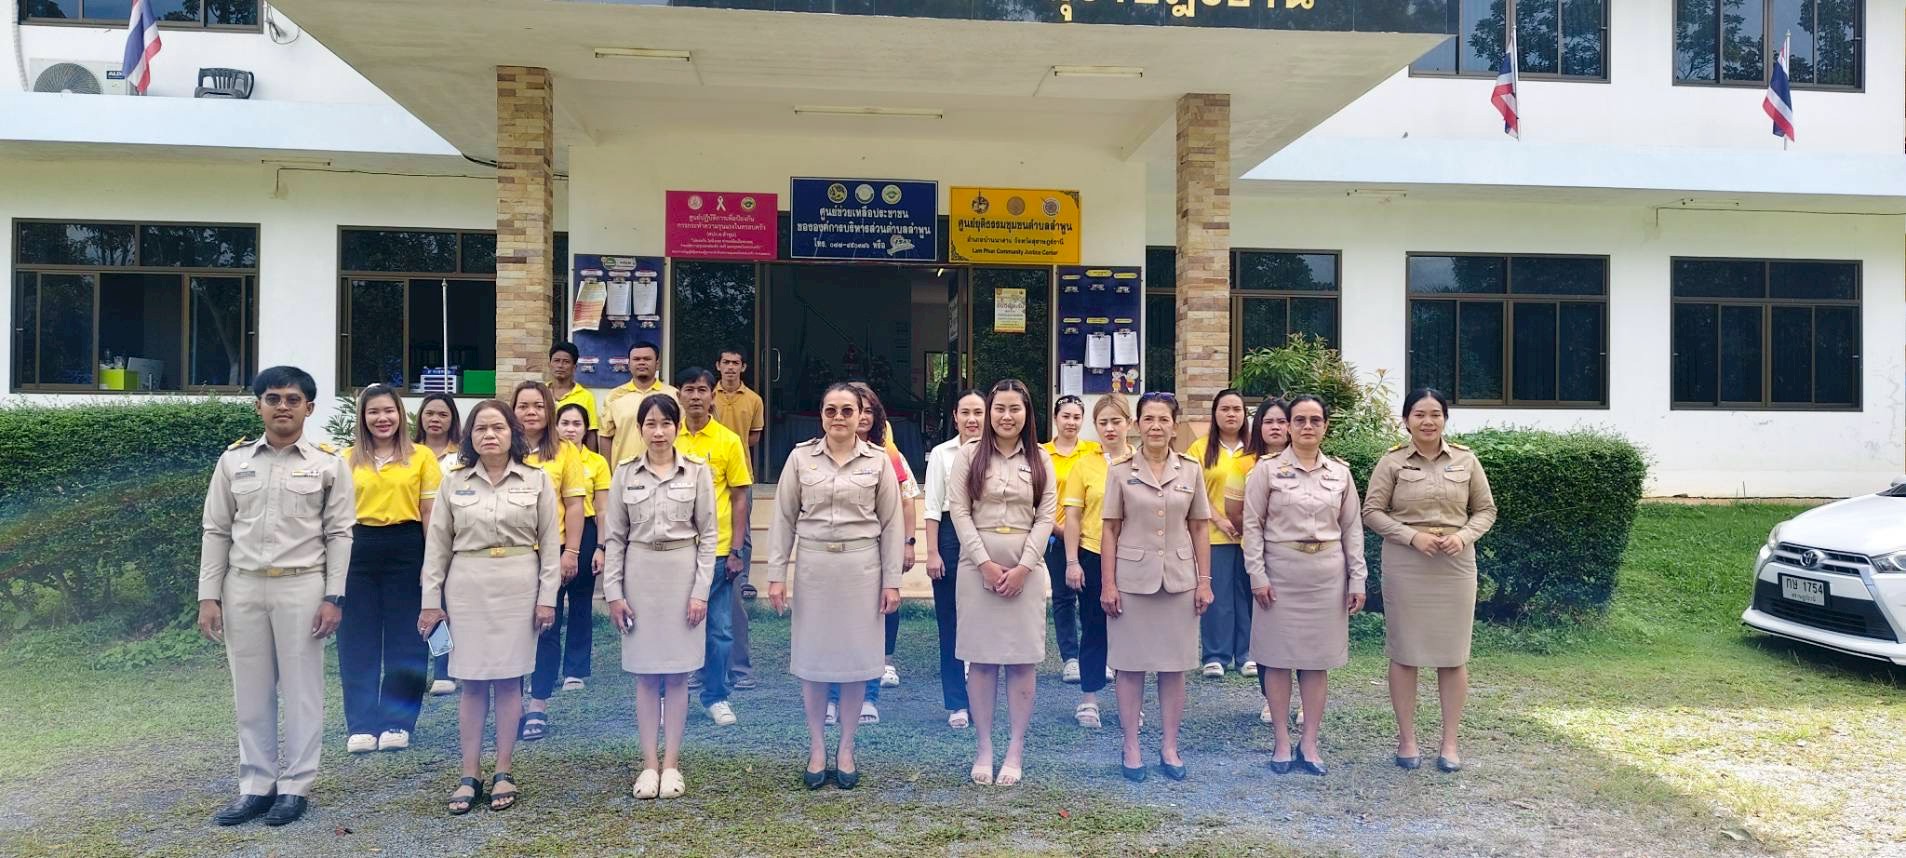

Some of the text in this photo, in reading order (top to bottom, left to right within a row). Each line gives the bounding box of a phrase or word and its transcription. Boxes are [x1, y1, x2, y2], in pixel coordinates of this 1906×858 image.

[820, 205, 909, 220] ศูนย์ช่วยเหลือประชาชน
[797, 221, 932, 239] ขององค์การบริหารส่วนตำบลลำพูน
[958, 217, 1073, 235] ศูนย์ยุติธรรมชุมชนตำบลลำพูน
[996, 248, 1024, 256] Community
[1803, 582, 1823, 594] 1754
